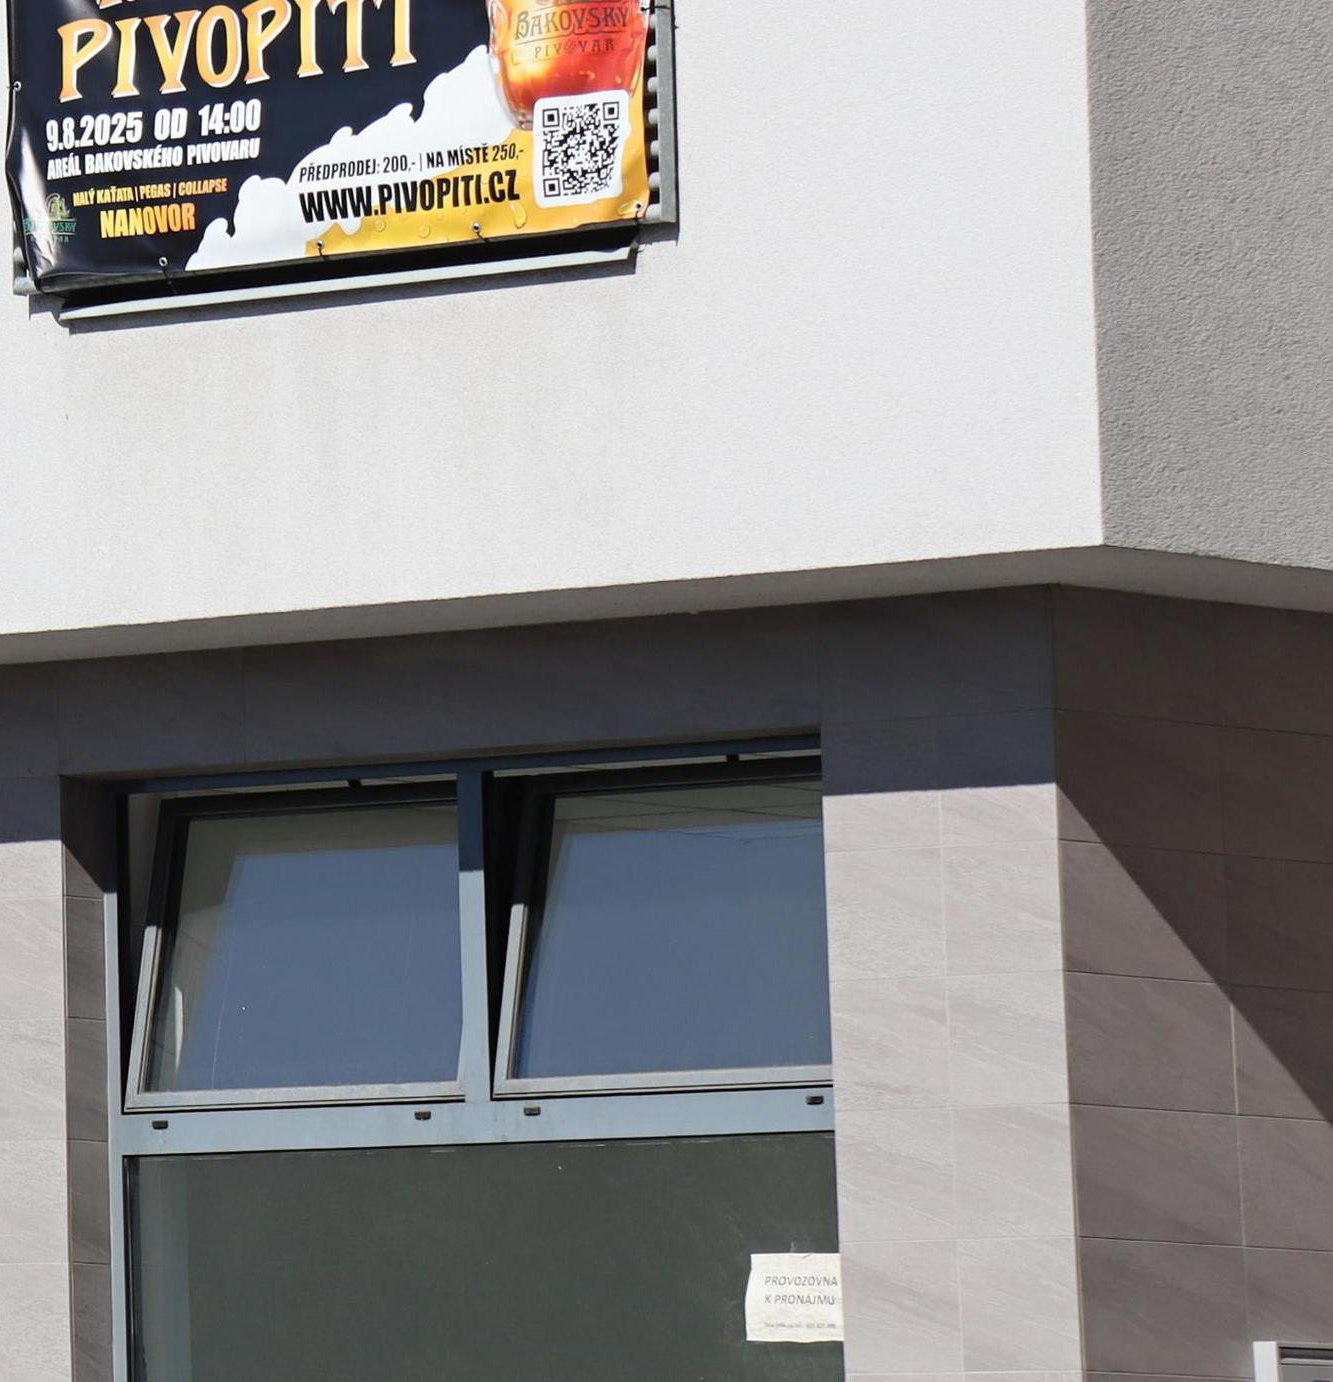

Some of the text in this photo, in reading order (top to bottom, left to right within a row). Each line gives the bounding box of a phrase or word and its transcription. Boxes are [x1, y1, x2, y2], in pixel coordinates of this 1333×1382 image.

[46, 99, 261, 152] 9.8.2025 OD 14:00
[47, 138, 261, 180] AREÁL BAKOVSKÉHO PIVOVARU
[299, 143, 524, 183] PŘEDPRODEJ: 200,- NA MÍSTĚ 250,-
[139, 183, 171, 200] PEGAS
[178, 178, 228, 197] COLLAPSE
[299, 169, 521, 223] WWW.PIVOPITI.CZ
[100, 202, 196, 238] NANOVOR
[764, 1275, 838, 1287] PROVOZOVNA
[764, 1294, 772, 1304] K
